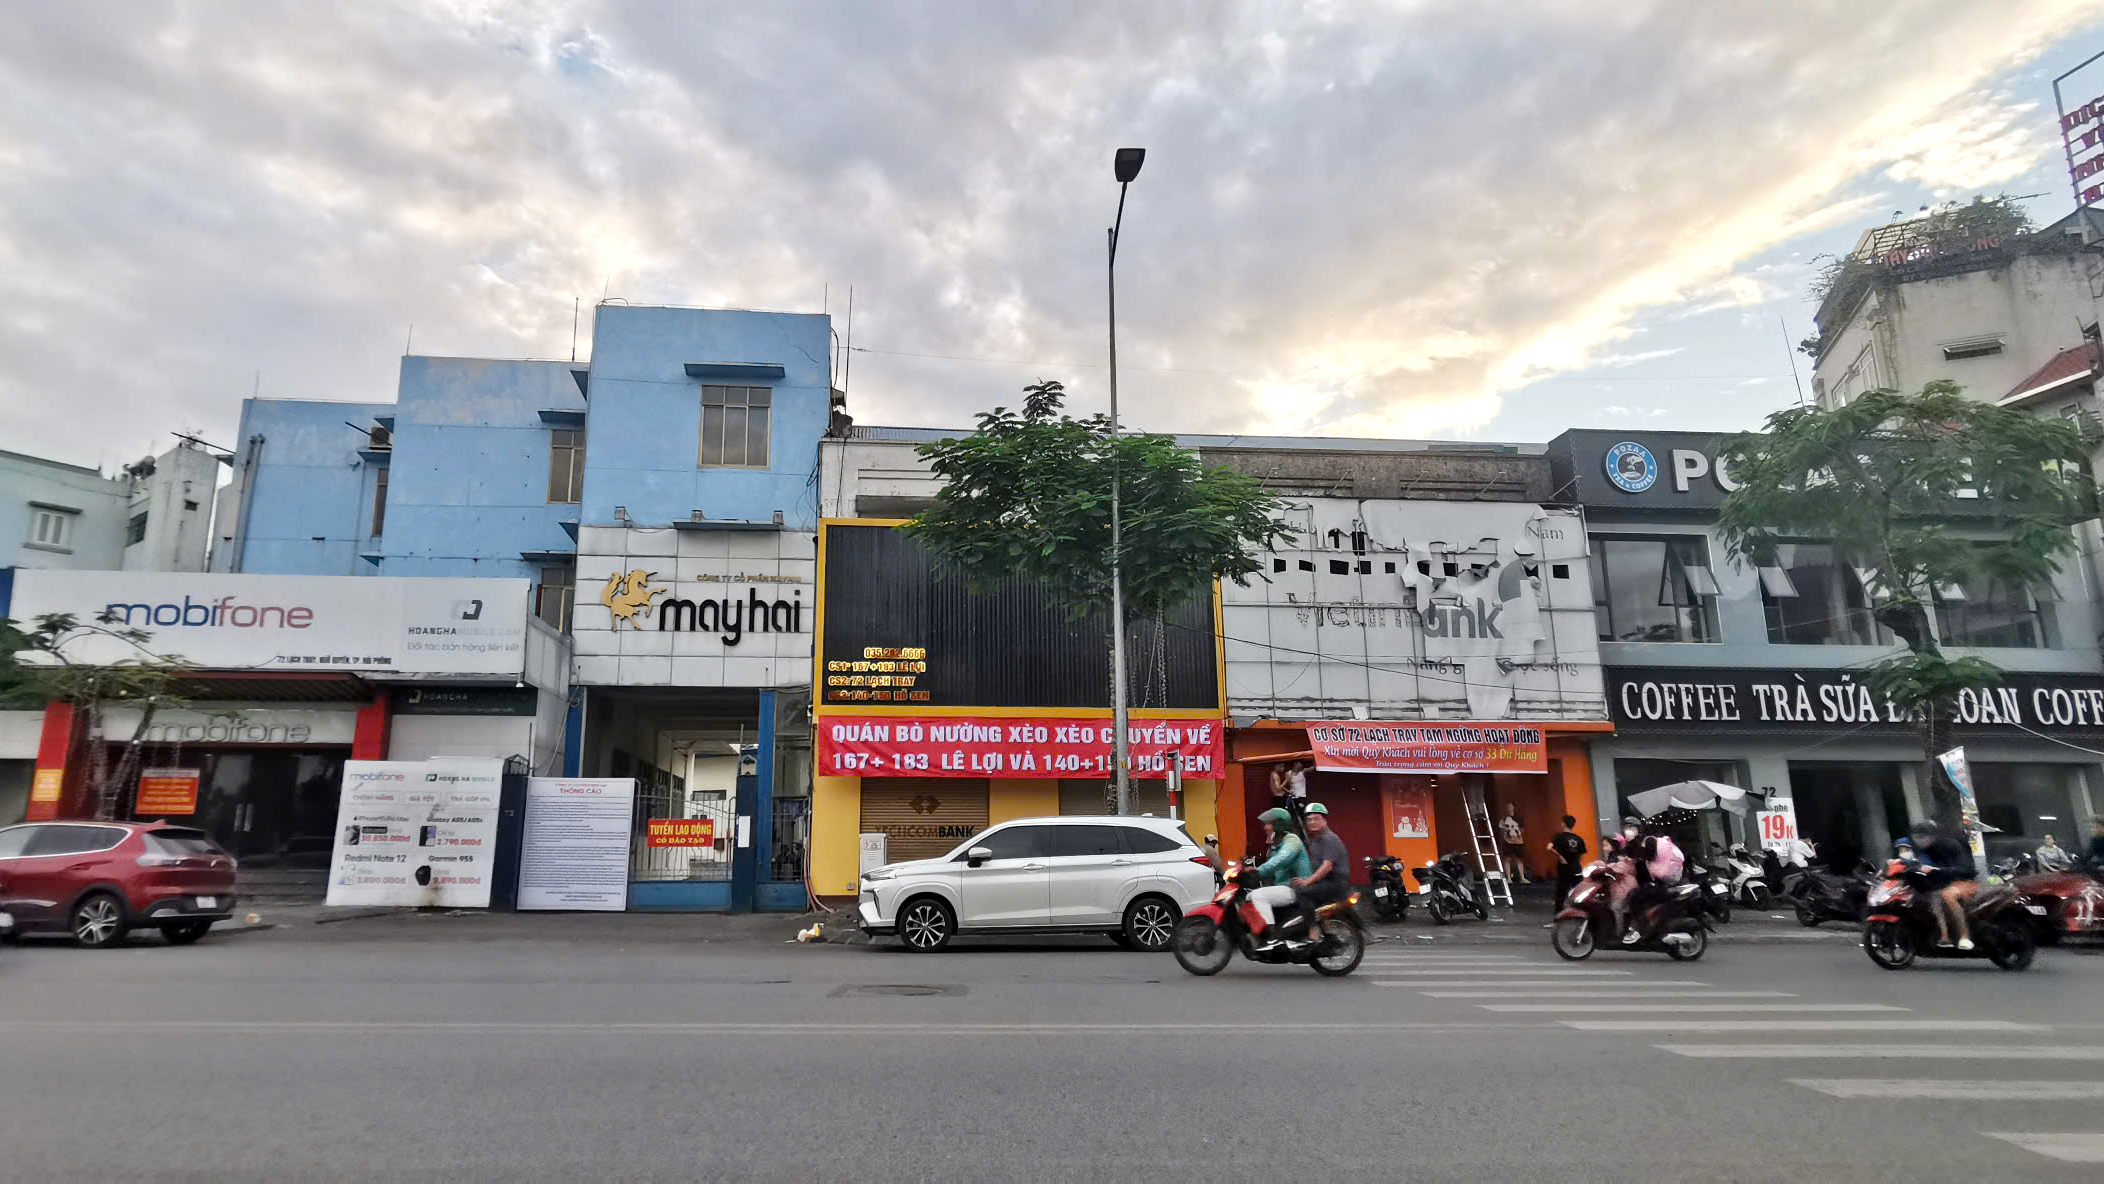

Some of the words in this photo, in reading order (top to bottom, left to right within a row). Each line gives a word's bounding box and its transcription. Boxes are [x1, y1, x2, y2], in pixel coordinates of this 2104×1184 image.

[1527, 526, 1564, 540] Nam
[106, 595, 314, 629] mobifone
[851, 677, 864, 686] 72
[865, 676, 890, 687] LẠCH
[892, 676, 915, 686] TRAY
[1621, 681, 1741, 721] COFFEE
[1752, 672, 1817, 722] TRÀ
[1953, 687, 2022, 725] OAN
[148, 717, 311, 743] mobifone
[832, 722, 889, 744] QUÁN
[896, 722, 924, 743] BÒ
[1008, 723, 1048, 744] XÈO
[1055, 724, 1095, 744] XÈO
[1100, 721, 1181, 745] CUYỂN
[1187, 723, 1211, 745] VỀ
[1313, 727, 1328, 742] CƠ
[1331, 723, 1345, 742] SỞ
[1347, 729, 1361, 741] 72
[1363, 728, 1390, 744] LẠCH
[1392, 728, 1418, 743] TRAY
[1420, 728, 1444, 745] TẠM
[1484, 729, 1510, 746] HOẠT
[1513, 726, 1540, 747] ĐỘNG
[892, 752, 930, 770] 183
[941, 750, 965, 771] LÊ
[971, 752, 1003, 774] LỢI
[1009, 750, 1036, 771] VÀ
[1138, 750, 1165, 772] HỒ
[1324, 746, 1340, 756] Xin
[1342, 746, 1360, 757] mời
[1362, 746, 1380, 759] Quý
[1382, 746, 1410, 758] Khách
[1413, 747, 1426, 757] vui
[1429, 747, 1448, 760] lòng
[1451, 745, 1460, 758] về
[1486, 748, 1497, 758] 33
[1762, 786, 1777, 797] 72
[650, 822, 674, 835] TUYỂN
[675, 824, 690, 835] LAO
[691, 823, 712, 836] ĐỘNG
[344, 854, 372, 862] Redmi
[373, 854, 395, 862] Note
